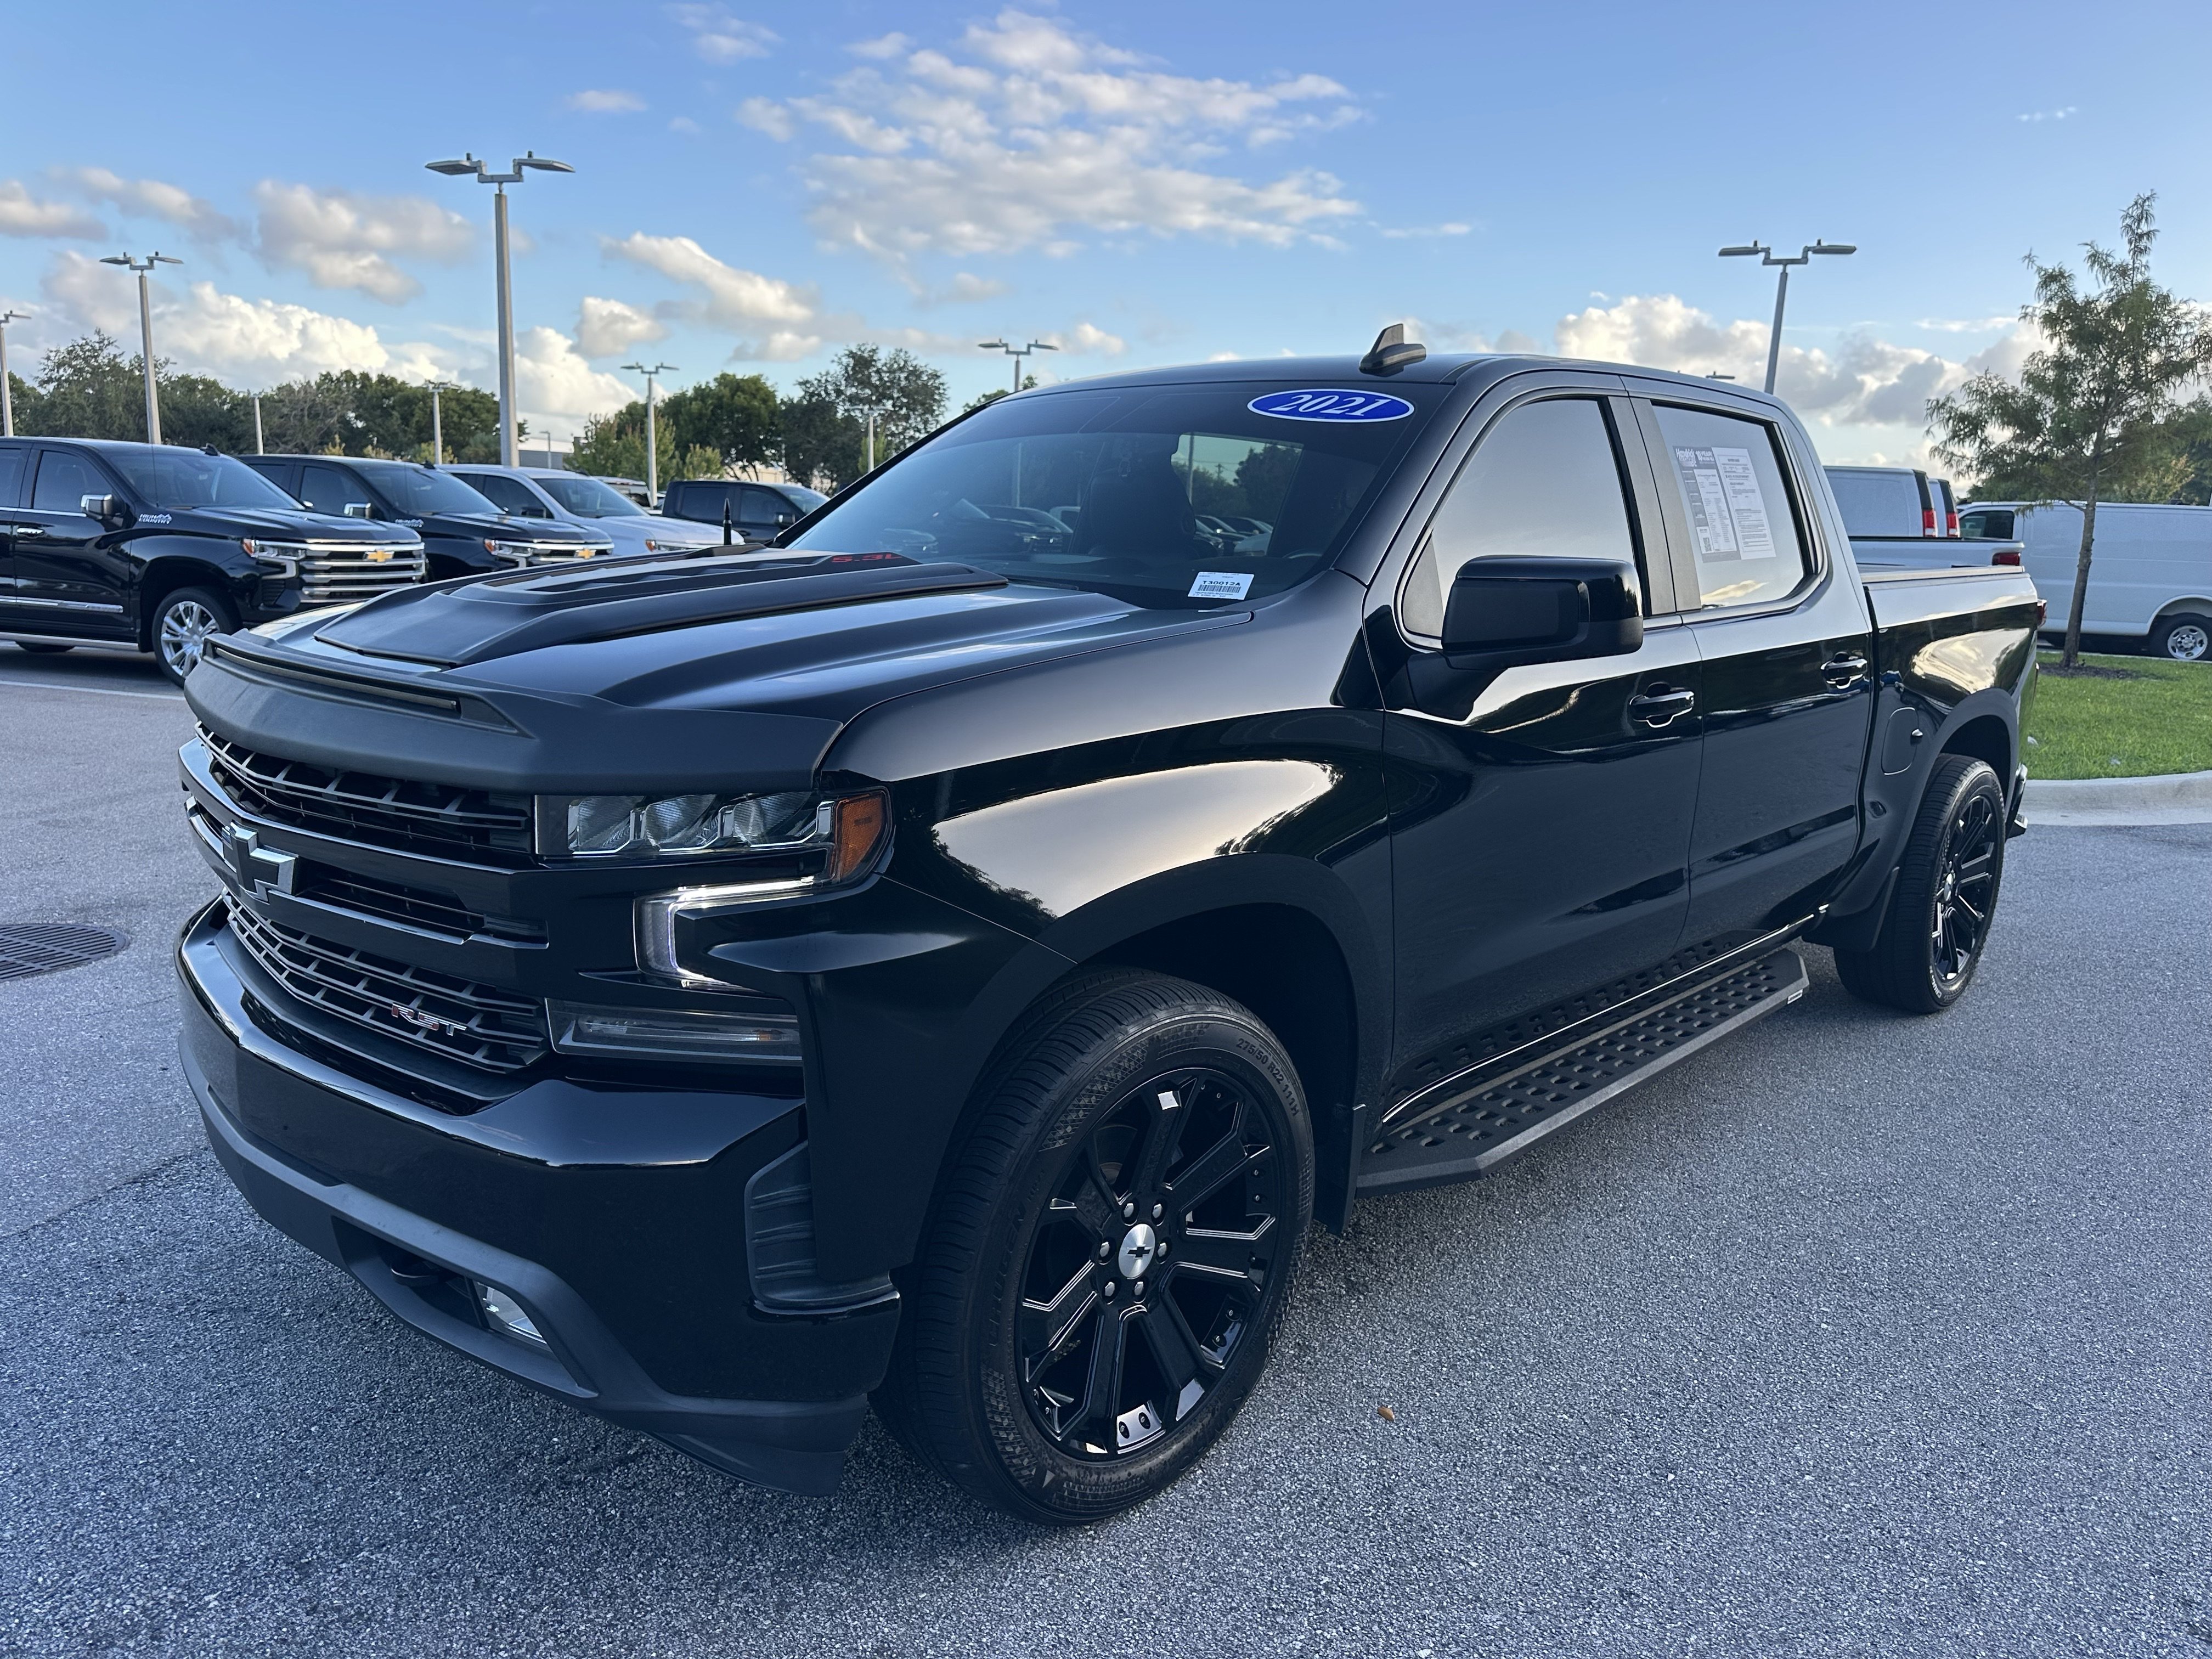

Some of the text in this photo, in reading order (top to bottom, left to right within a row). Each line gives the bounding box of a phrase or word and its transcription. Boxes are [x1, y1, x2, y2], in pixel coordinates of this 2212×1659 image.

[1268, 394, 1392, 416] 2021
[831, 554, 903, 563] 5.3L
[391, 1002, 467, 1036] RST
[1235, 1038, 1299, 1116] 275/50 R22 111H
